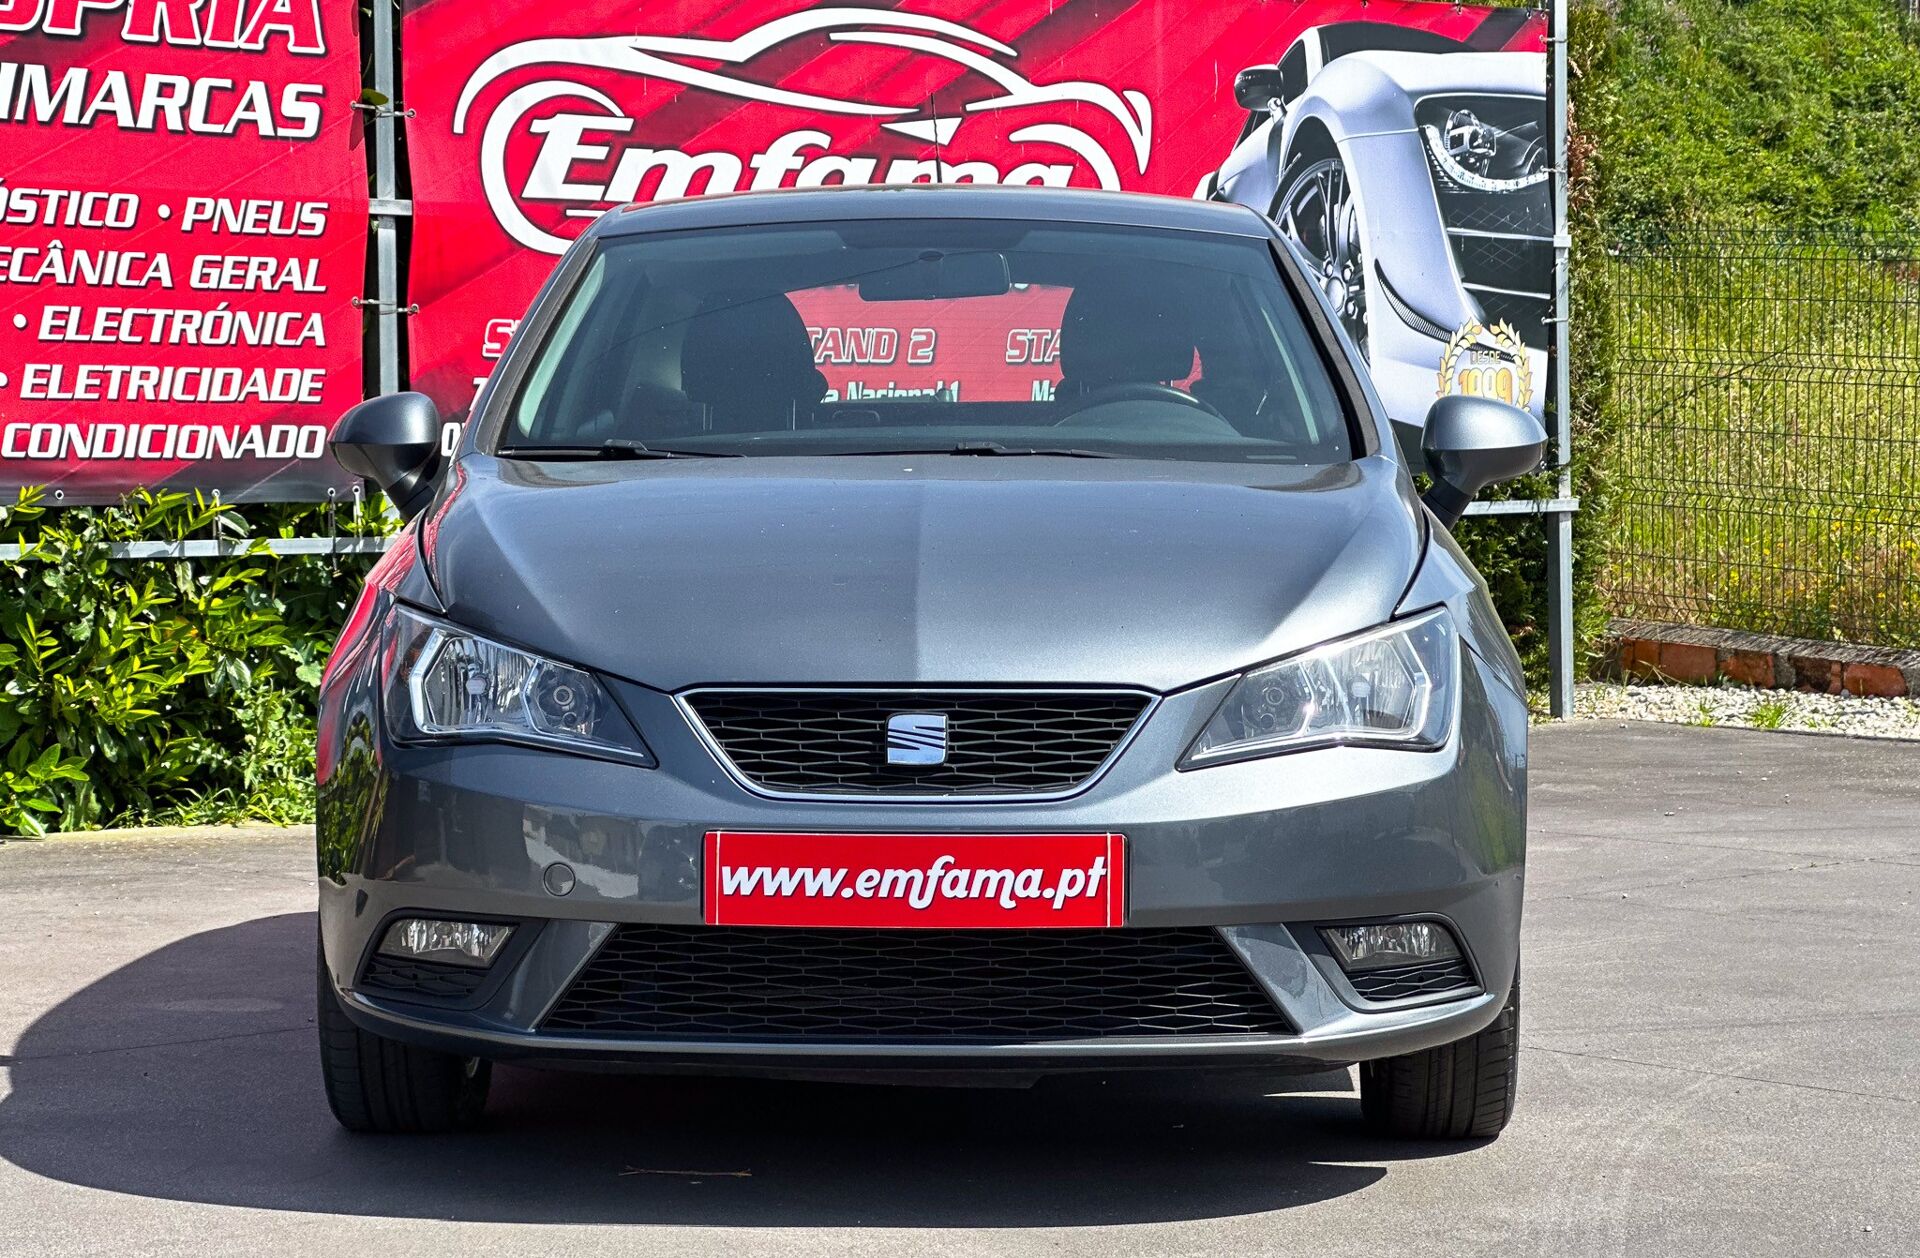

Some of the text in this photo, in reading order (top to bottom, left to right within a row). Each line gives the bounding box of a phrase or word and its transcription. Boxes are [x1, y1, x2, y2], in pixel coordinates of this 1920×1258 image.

[0, 0, 325, 54] RIA
[0, 177, 328, 236] STICO PNEUS
[190, 255, 326, 292] GERAL
[38, 302, 326, 346] ELECTRÓNICA
[907, 328, 936, 363] 2
[20, 364, 326, 402] ELETRICIDADE
[1, 423, 327, 459] CONDICIONADO
[721, 855, 1107, 909] www.emfama.pt
